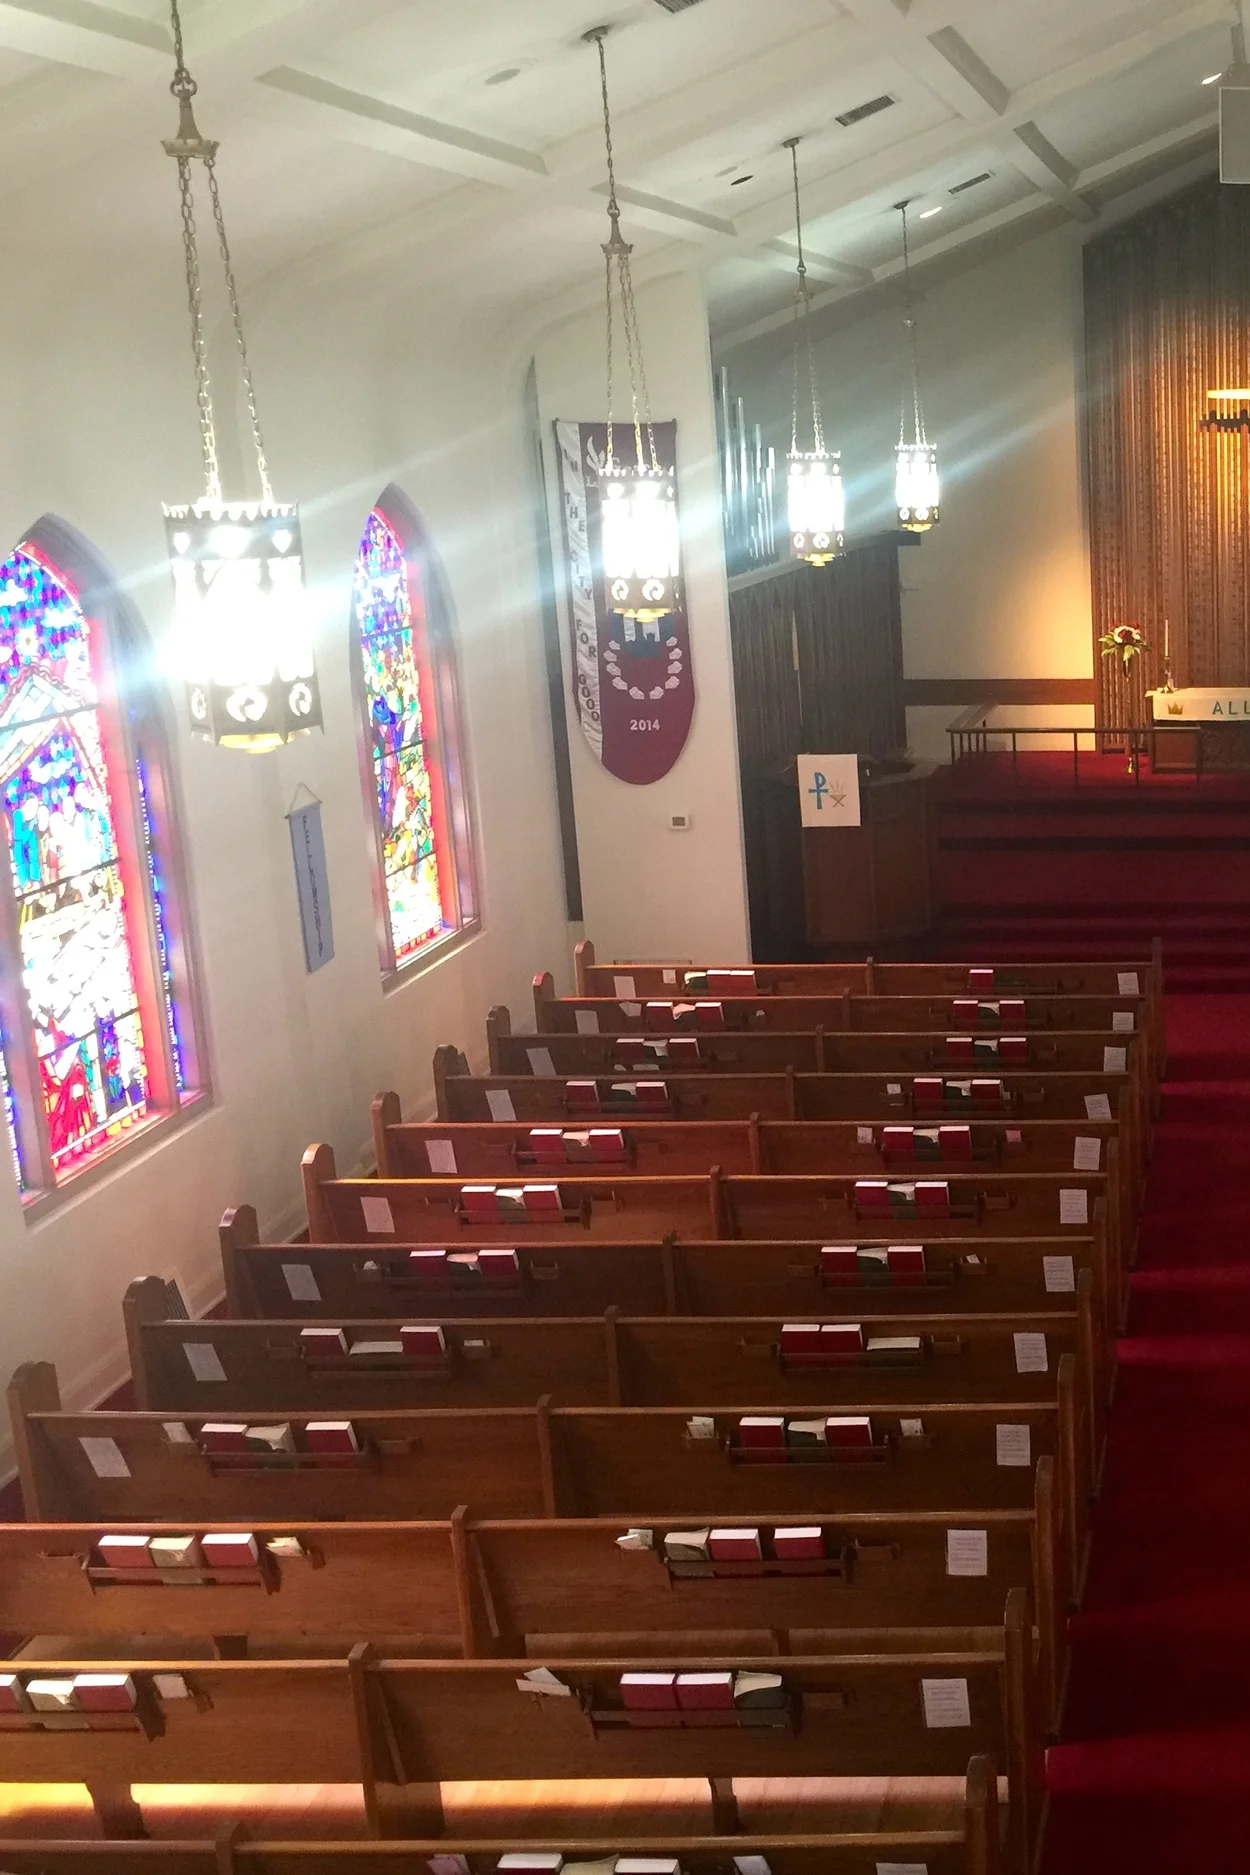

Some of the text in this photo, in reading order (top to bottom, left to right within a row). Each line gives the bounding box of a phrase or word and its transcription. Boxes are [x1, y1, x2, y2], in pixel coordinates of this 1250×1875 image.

[563, 448, 600, 721] IN THE CITY FOR GOOD
[629, 718, 661, 731] 2014
